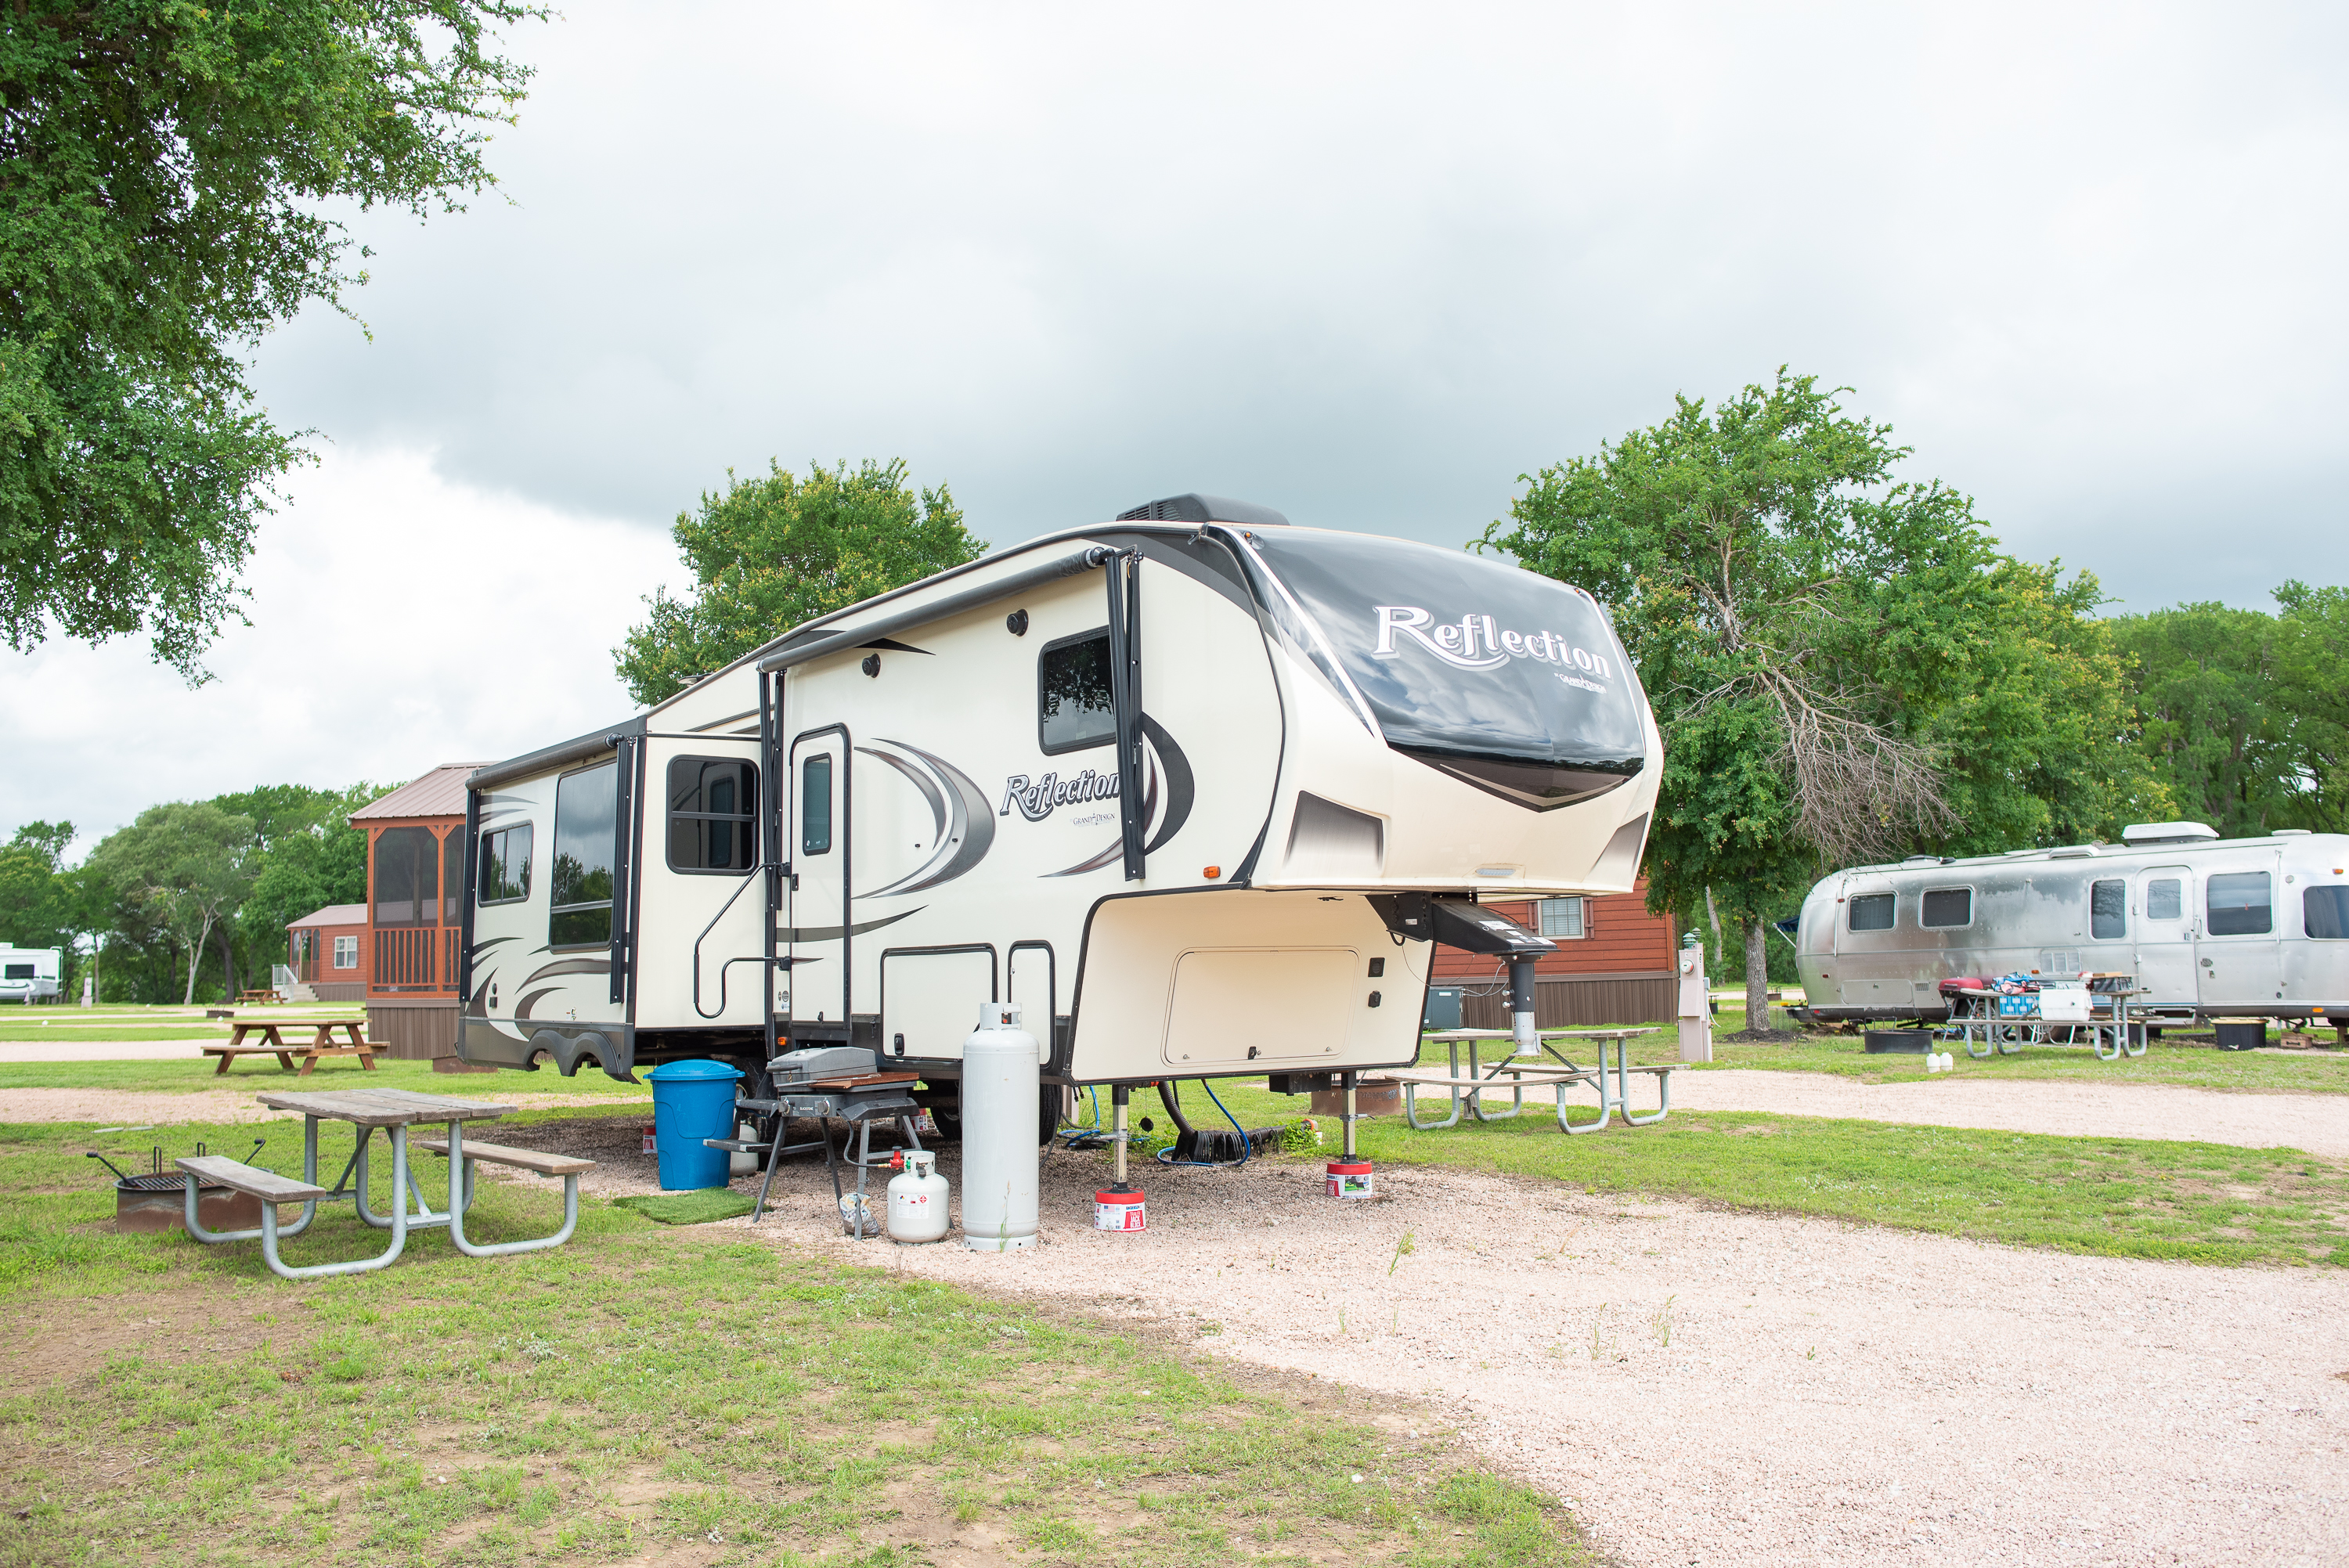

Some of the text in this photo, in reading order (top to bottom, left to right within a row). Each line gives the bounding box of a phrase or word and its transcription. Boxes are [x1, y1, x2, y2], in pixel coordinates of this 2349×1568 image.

[1371, 605, 1615, 684] Reflection
[1000, 770, 1120, 822] Reflection
[1073, 816, 1092, 824] GRAND
[1096, 813, 1115, 821] DESIGN
